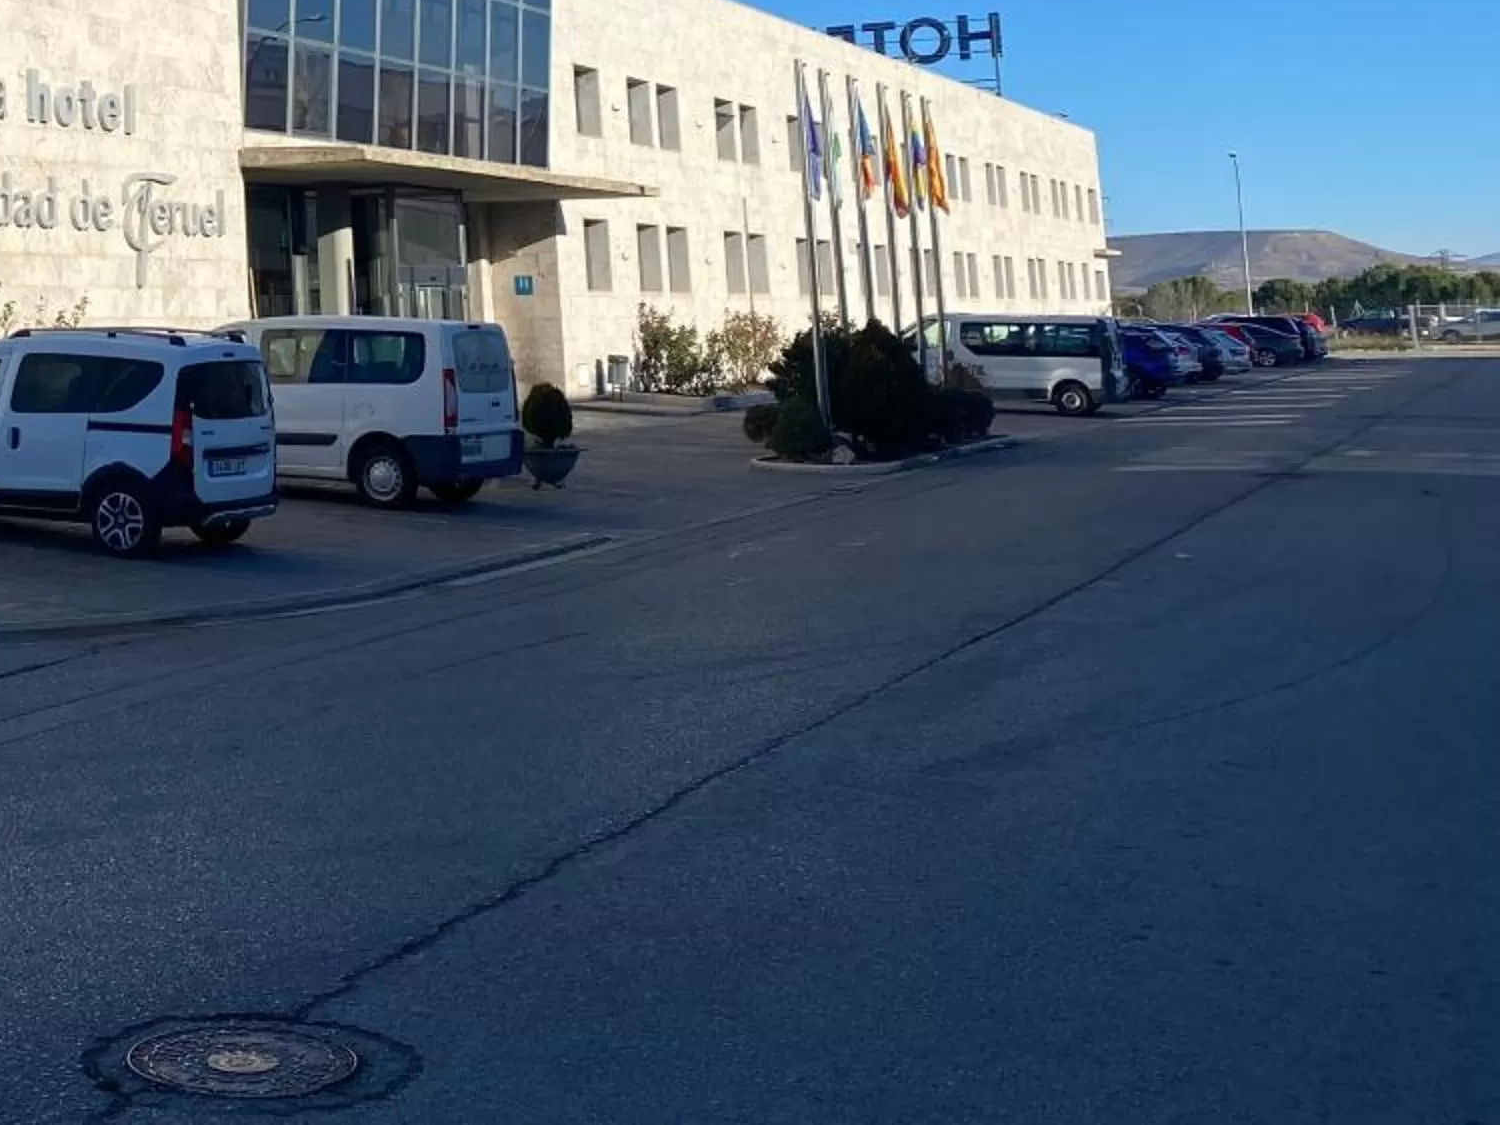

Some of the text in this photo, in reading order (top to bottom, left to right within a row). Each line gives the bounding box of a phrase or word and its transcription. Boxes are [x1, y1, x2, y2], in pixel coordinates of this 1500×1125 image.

[26, 68, 138, 136] hotel
[69, 178, 114, 232] de
[121, 172, 226, 290] Teruel
